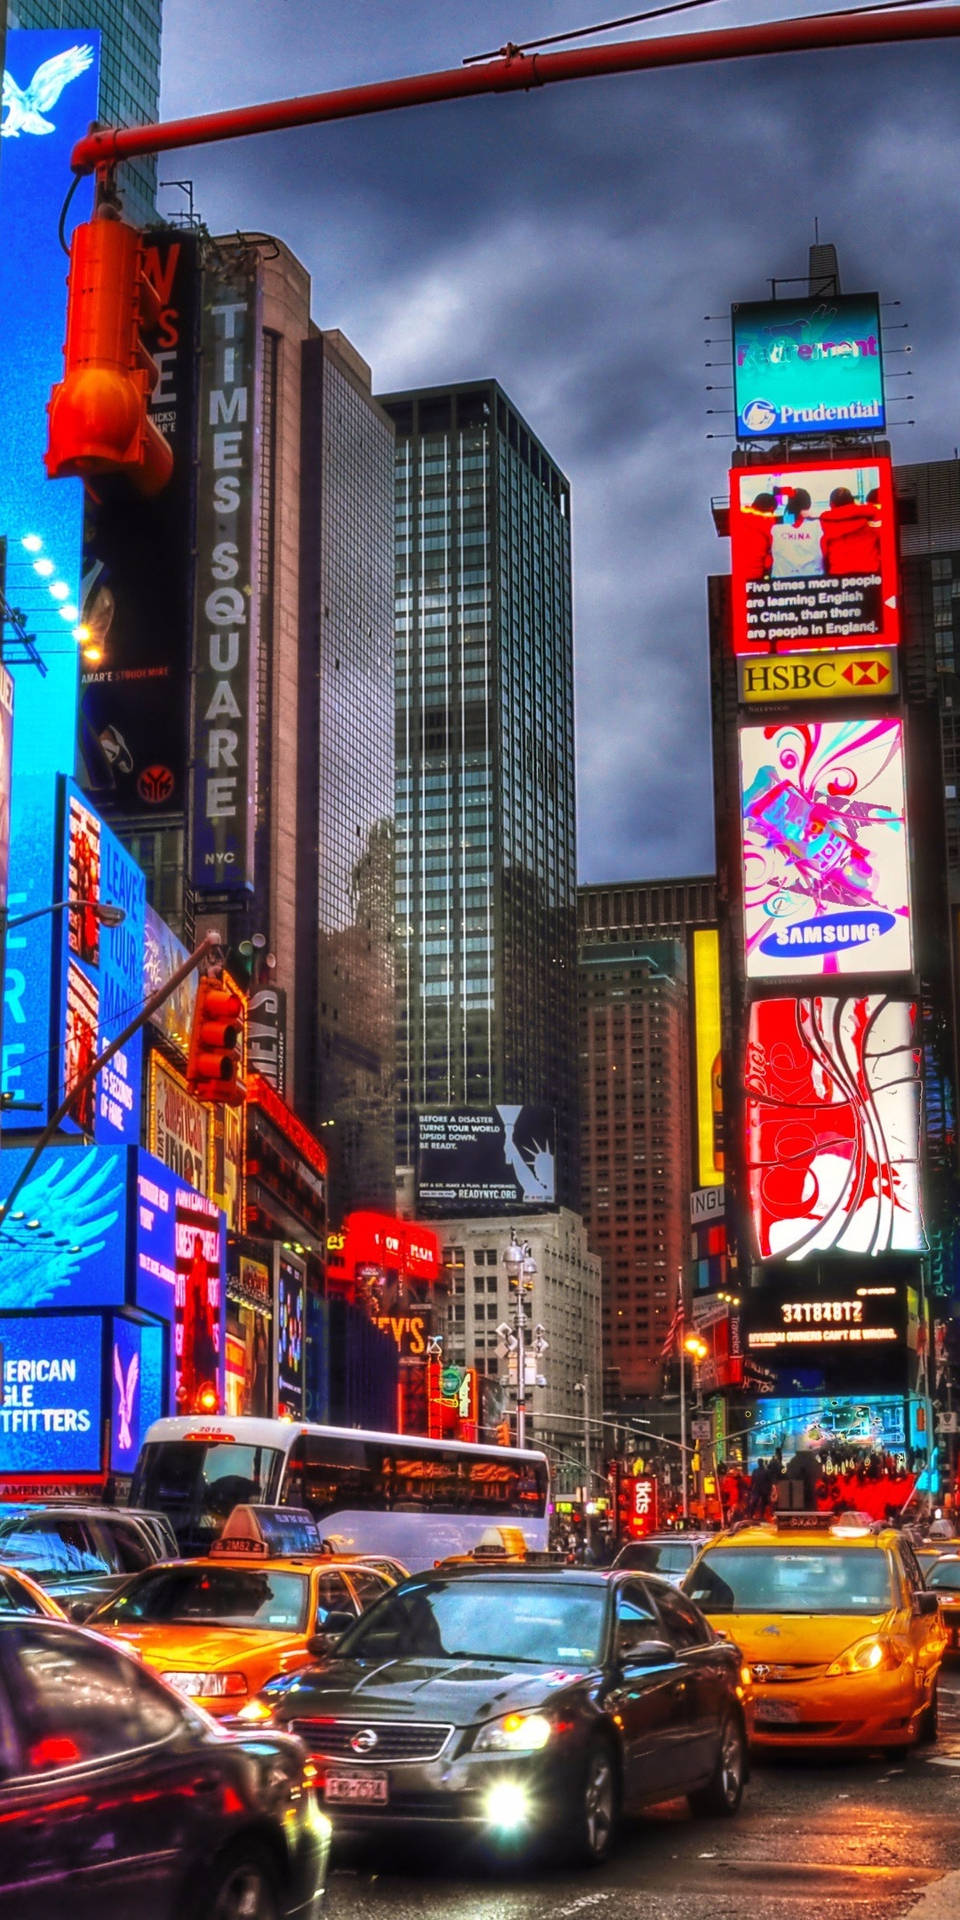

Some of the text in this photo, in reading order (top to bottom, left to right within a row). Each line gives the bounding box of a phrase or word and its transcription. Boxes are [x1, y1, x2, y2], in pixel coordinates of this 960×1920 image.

[780, 401, 880, 424] Prudential
[204, 303, 248, 819] TIMES SQUARE
[746, 575, 882, 592] Five times more people
[746, 591, 864, 608] are learning English
[747, 607, 861, 623] in China, than there
[747, 621, 879, 640] are people in England.
[82, 672, 113, 683] AMAR'E
[745, 663, 837, 692] HSBC
[205, 852, 236, 865] NYC
[776, 923, 881, 945] SAMSUNG
[458, 1190, 517, 1199] READYNYC.ORG
[731, 1316, 740, 1354] Travelex
[823, 1331, 848, 1341] CAN'T
[4, 1359, 76, 1382] ERICAN
[2, 1484, 71, 1496] AMERICAN
[635, 1481, 652, 1515] tkts
